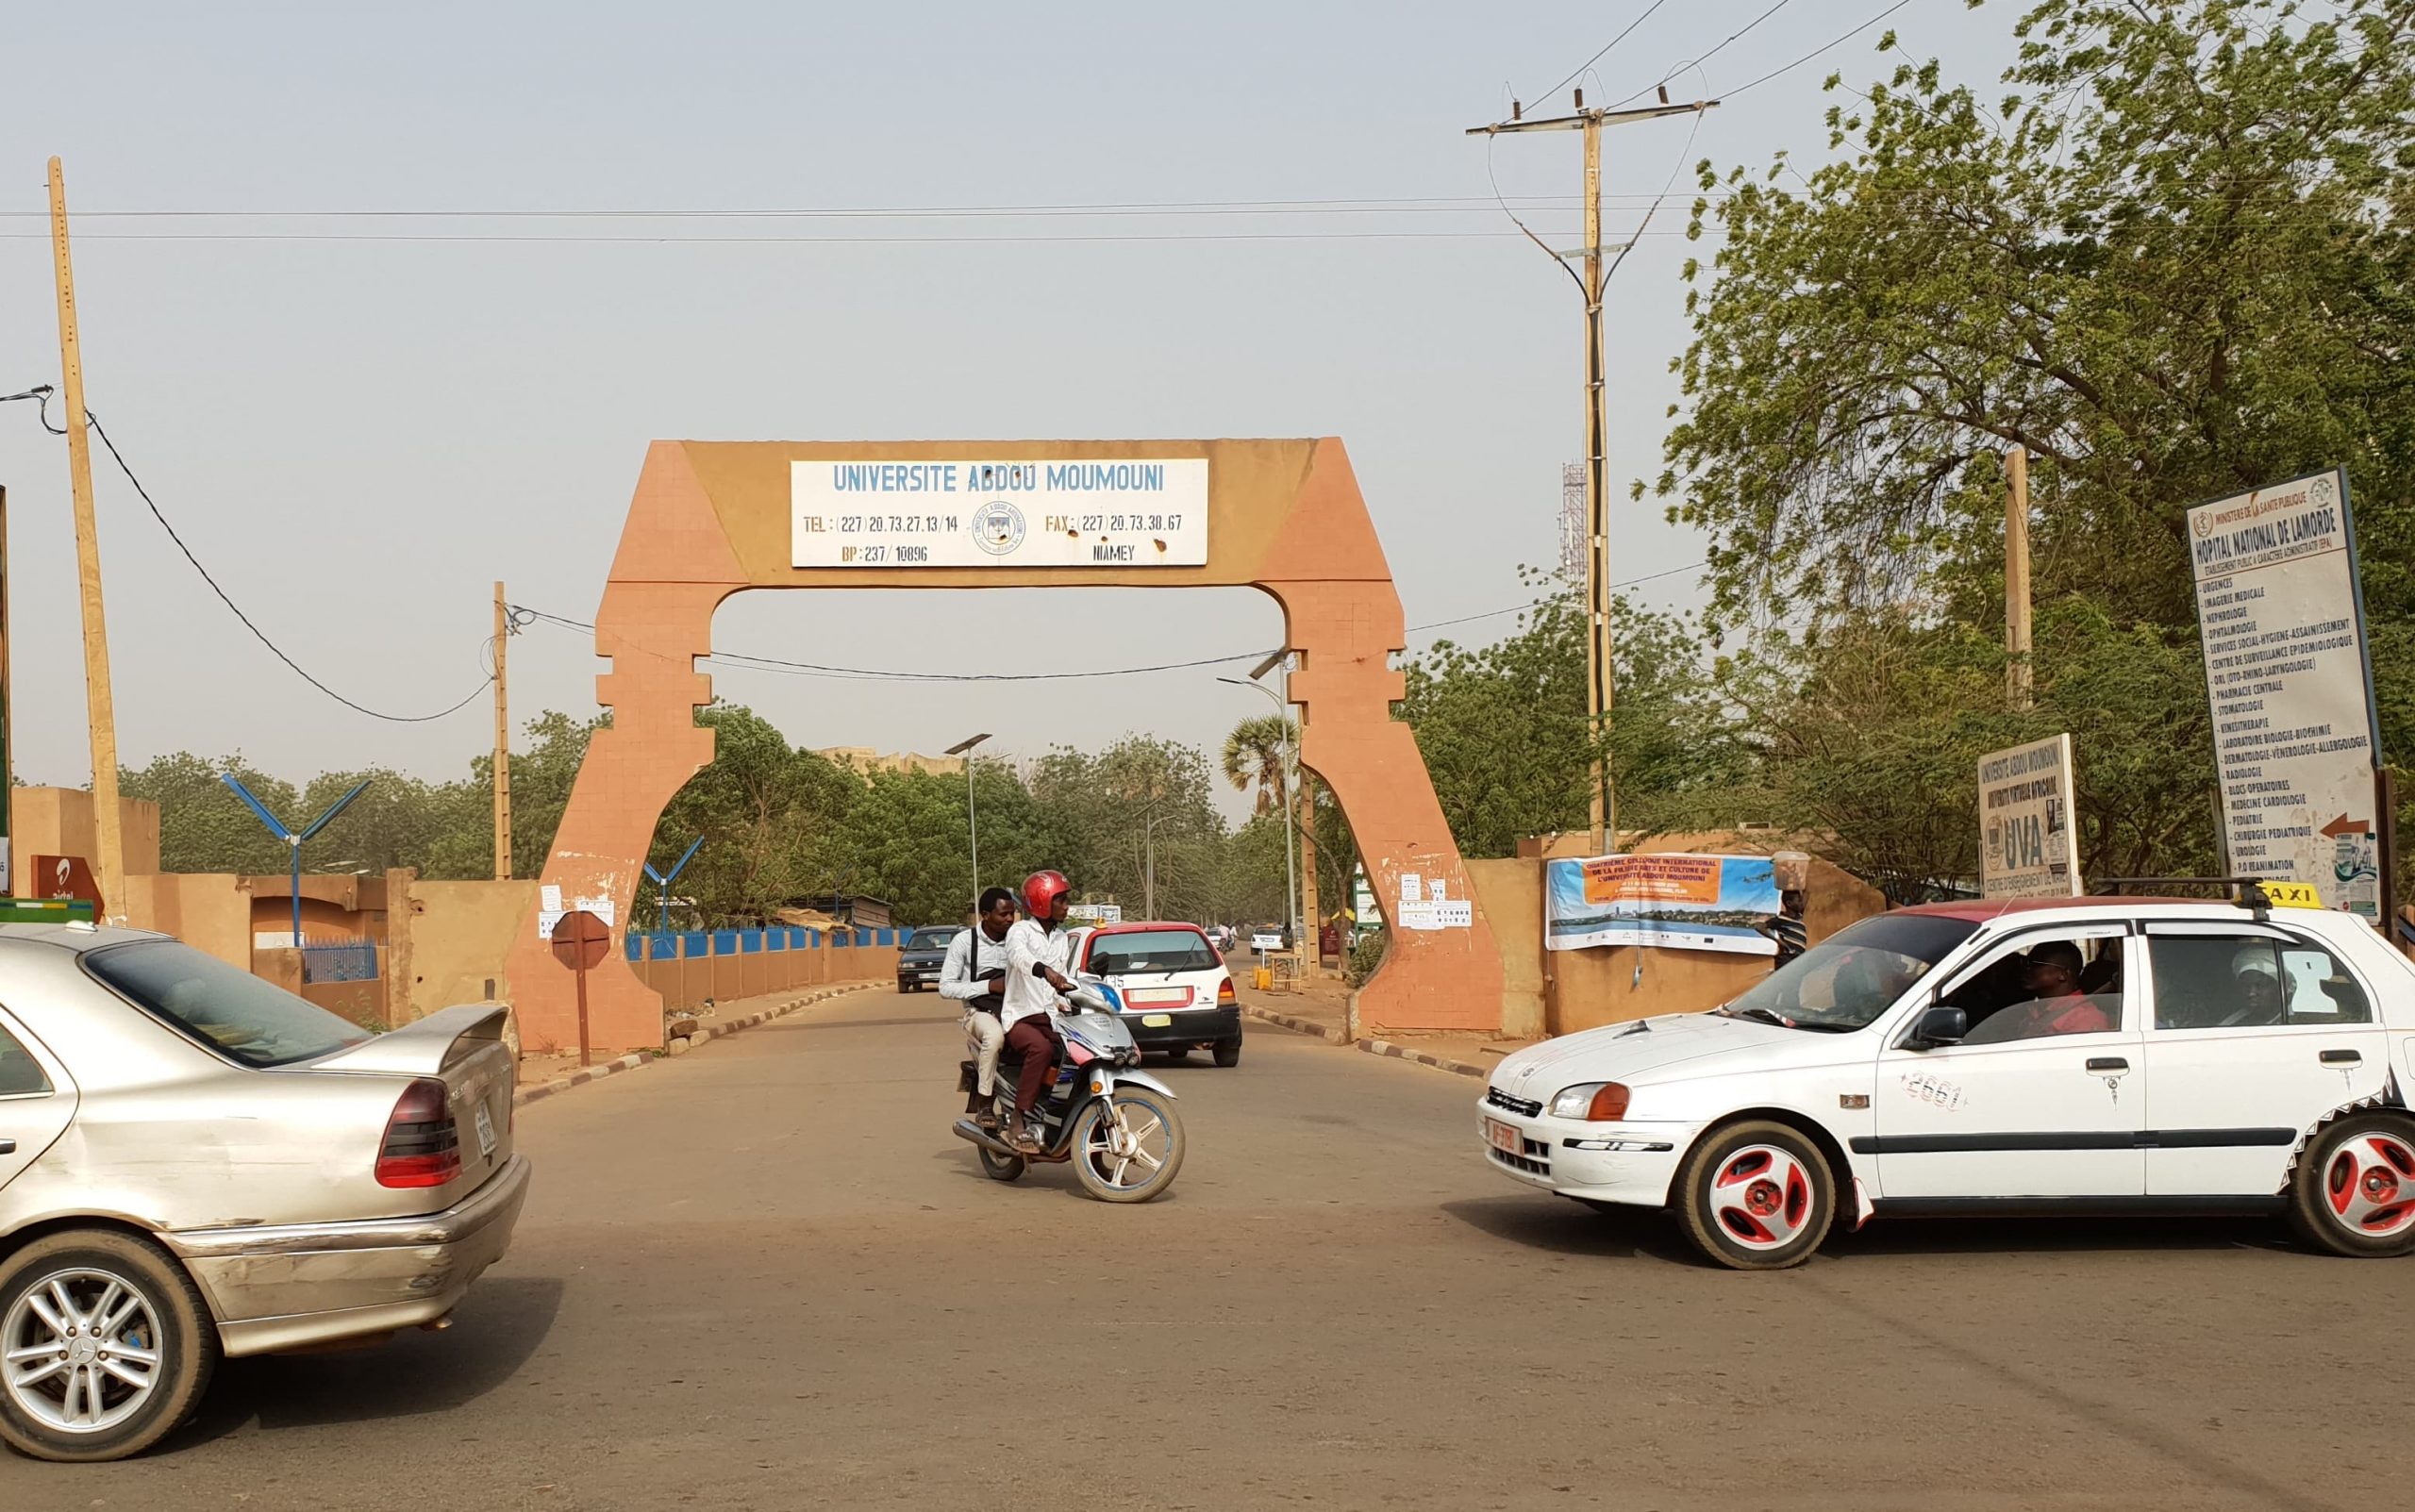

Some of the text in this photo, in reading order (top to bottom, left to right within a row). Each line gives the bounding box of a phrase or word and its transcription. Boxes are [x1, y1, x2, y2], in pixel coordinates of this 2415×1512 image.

[833, 464, 1164, 491] UNIVERSITE ABDOU MOUMOUNI
[2195, 507, 2337, 565] HOPITAL NATIONAL DE LAMORDE
[1093, 544, 1136, 561] NIAMEY
[2203, 577, 2233, 594] URGENCES
[2205, 587, 2265, 609] IMAGERIE MEDICALE
[2206, 607, 2247, 624] NEPHROLOGIE
[2208, 621, 2257, 640] OPHTALMOLOGIE
[2209, 638, 2237, 656] SERVICES
[2211, 634, 2353, 671] CENTRE DE SURVEILLANCE EPIDEMIOLOGIQUE
[2214, 671, 2225, 685] ORL
[2216, 680, 2283, 701] PHARMACIE CENTRALE
[2218, 700, 2264, 717] STOMATOLOGIE
[2221, 718, 2269, 734] KINESITHERAPIE
[2223, 733, 2263, 749] LABORATOIRE
[2225, 766, 2262, 780] RADIOLOGIE
[2228, 780, 2290, 796] BLOCS OPERATOIRES
[2231, 794, 2307, 810] MEDECINE CARDIOLOGIE
[2232, 813, 2263, 825] PEDIATRIE
[2234, 825, 2311, 841] CHIRURGIE PEDIATRIQUE
[2004, 814, 2044, 870] UVA
[2236, 845, 2267, 857] UROLOGIE
[1662, 857, 1716, 867] INTERNATIONAL
[2249, 859, 2294, 872] REANIMATION
